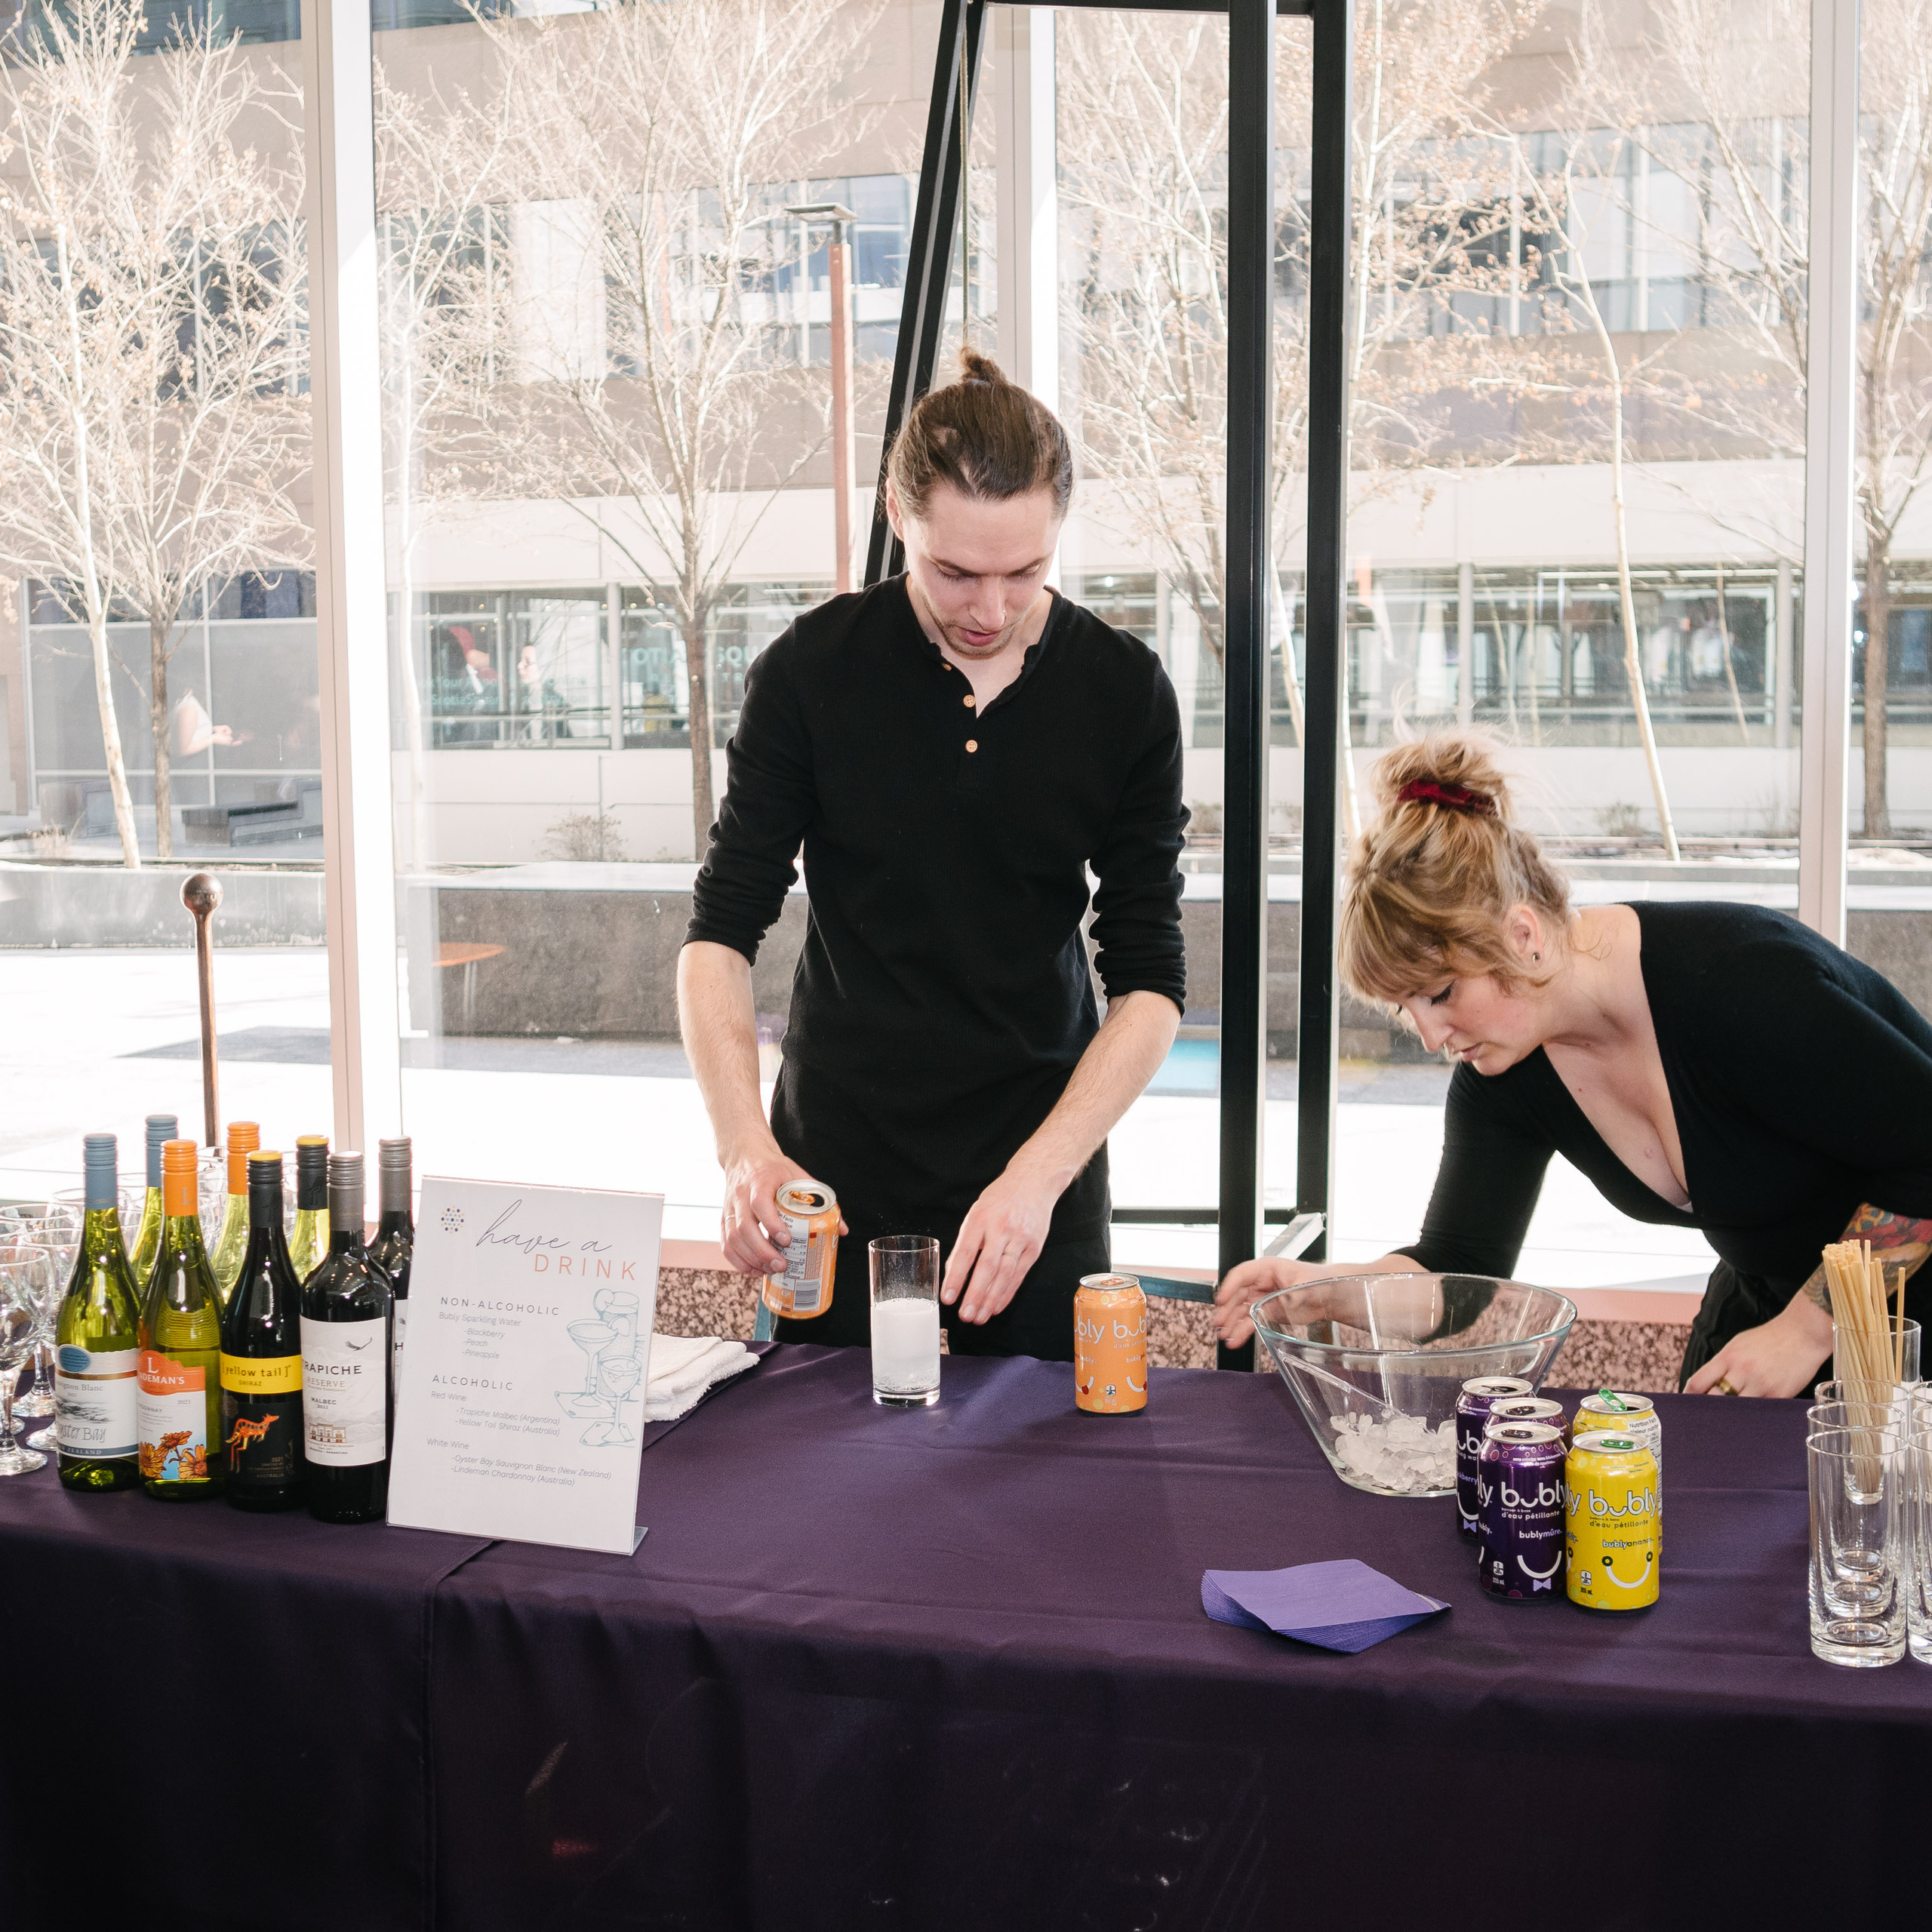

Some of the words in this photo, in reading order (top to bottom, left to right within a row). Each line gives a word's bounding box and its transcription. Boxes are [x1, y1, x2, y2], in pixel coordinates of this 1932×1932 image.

[476, 1198, 570, 1254] have
[580, 1240, 613, 1253] a
[534, 1254, 637, 1281] DRINK
[440, 1297, 560, 1315] NON-ALCOHOLIC
[438, 1312, 460, 1322] Bubly
[462, 1314, 497, 1326] Sparkling
[498, 1317, 522, 1327] Water
[147, 1357, 158, 1374] L
[139, 1374, 185, 1384] NDEMAN'S
[307, 1377, 346, 1388] RESERVE
[432, 1374, 513, 1390] ALCOHOLIC
[311, 1397, 337, 1405] MALBEC
[431, 1390, 447, 1399] Red
[448, 1392, 467, 1401] Wine
[493, 1411, 518, 1420] Malbec
[520, 1414, 560, 1426] (Argentina)
[484, 1420, 497, 1429] Tail
[499, 1422, 521, 1432] Shiraz
[522, 1424, 560, 1436] (Australia)
[67, 1447, 102, 1455] ZEALAND
[426, 1438, 449, 1447] White
[451, 1441, 469, 1450] Wine
[480, 1457, 494, 1467] Bay
[496, 1459, 534, 1471] Sauvignon
[535, 1463, 556, 1473] Blanc
[557, 1466, 577, 1475] (New
[579, 1468, 612, 1480] Zealand)
[491, 1469, 536, 1482] Chardonnay
[537, 1474, 575, 1486] (Australia)
[1589, 1487, 1657, 1518] bubly
[1525, 1511, 1560, 1521] pétillante
[1614, 1519, 1649, 1529] pétillante
